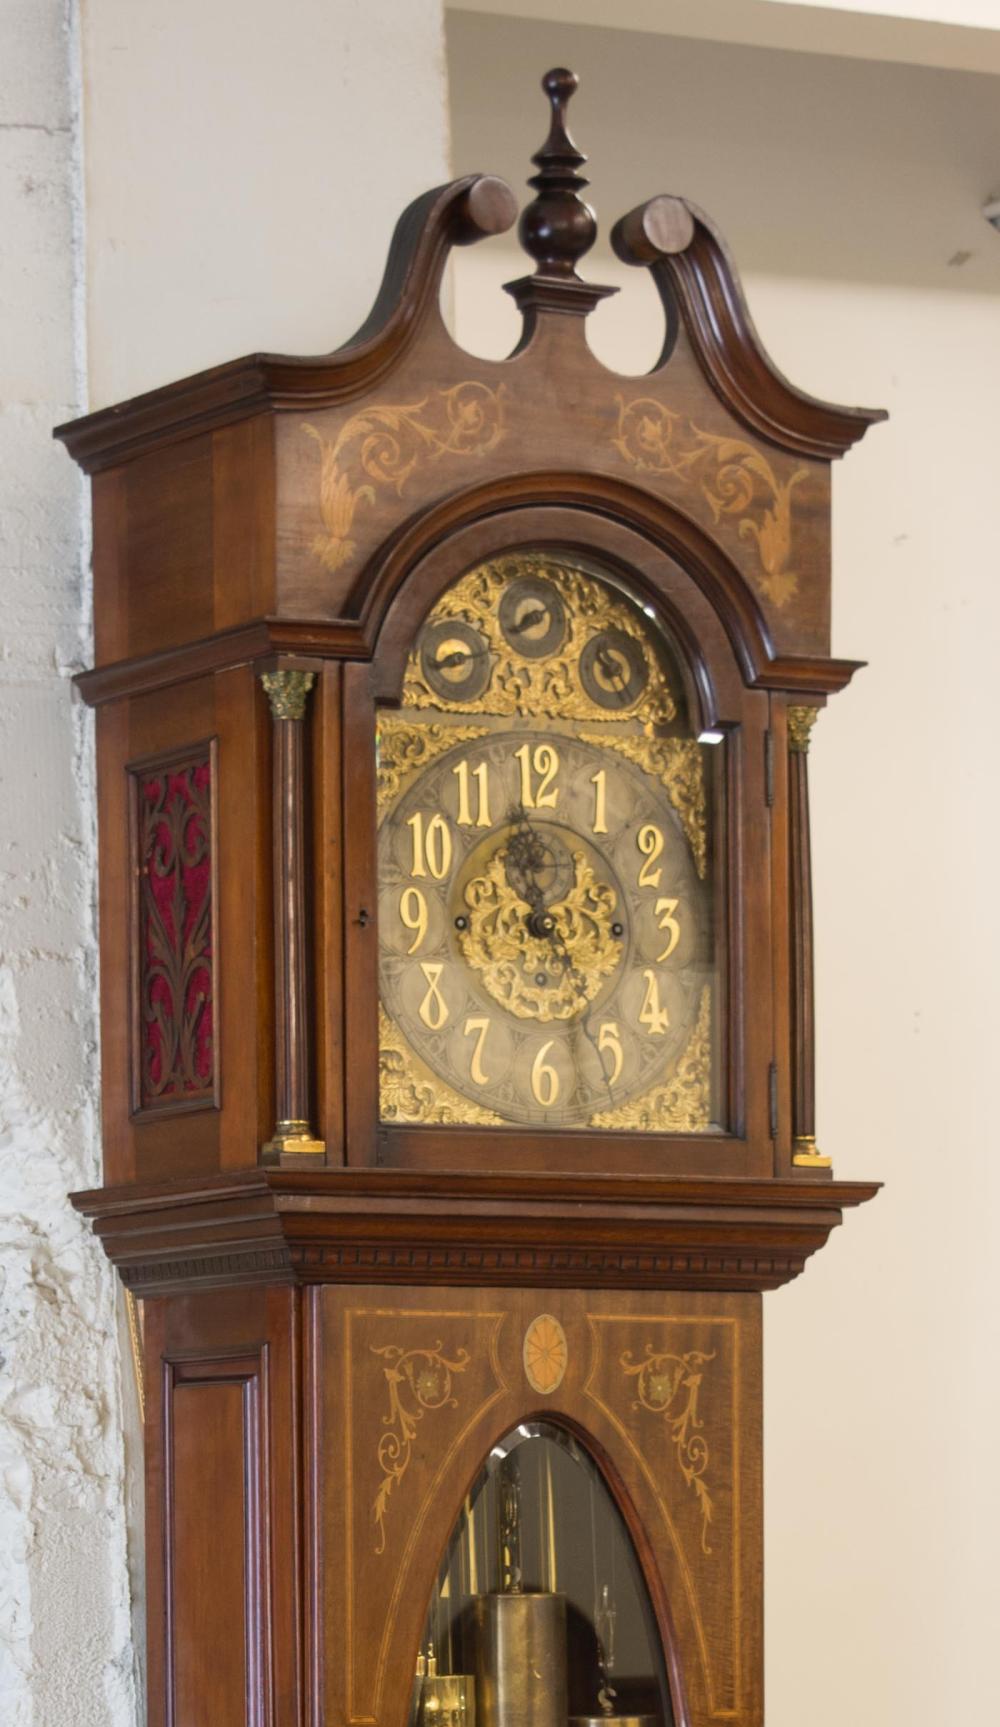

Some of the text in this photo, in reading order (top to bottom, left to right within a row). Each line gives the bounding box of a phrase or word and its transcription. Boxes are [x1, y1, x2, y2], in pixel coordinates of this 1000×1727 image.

[453, 760, 492, 827] 11
[514, 743, 560, 808] 12
[591, 769, 608, 833] 1
[407, 812, 452, 879] 10
[637, 824, 664, 888] 2
[400, 887, 428, 954] 9
[655, 898, 681, 963] 3
[419, 963, 449, 1030] 8
[639, 969, 670, 1034] 4
[463, 1018, 490, 1084] 7
[531, 1041, 559, 1106] 6
[598, 1022, 623, 1086] 5
